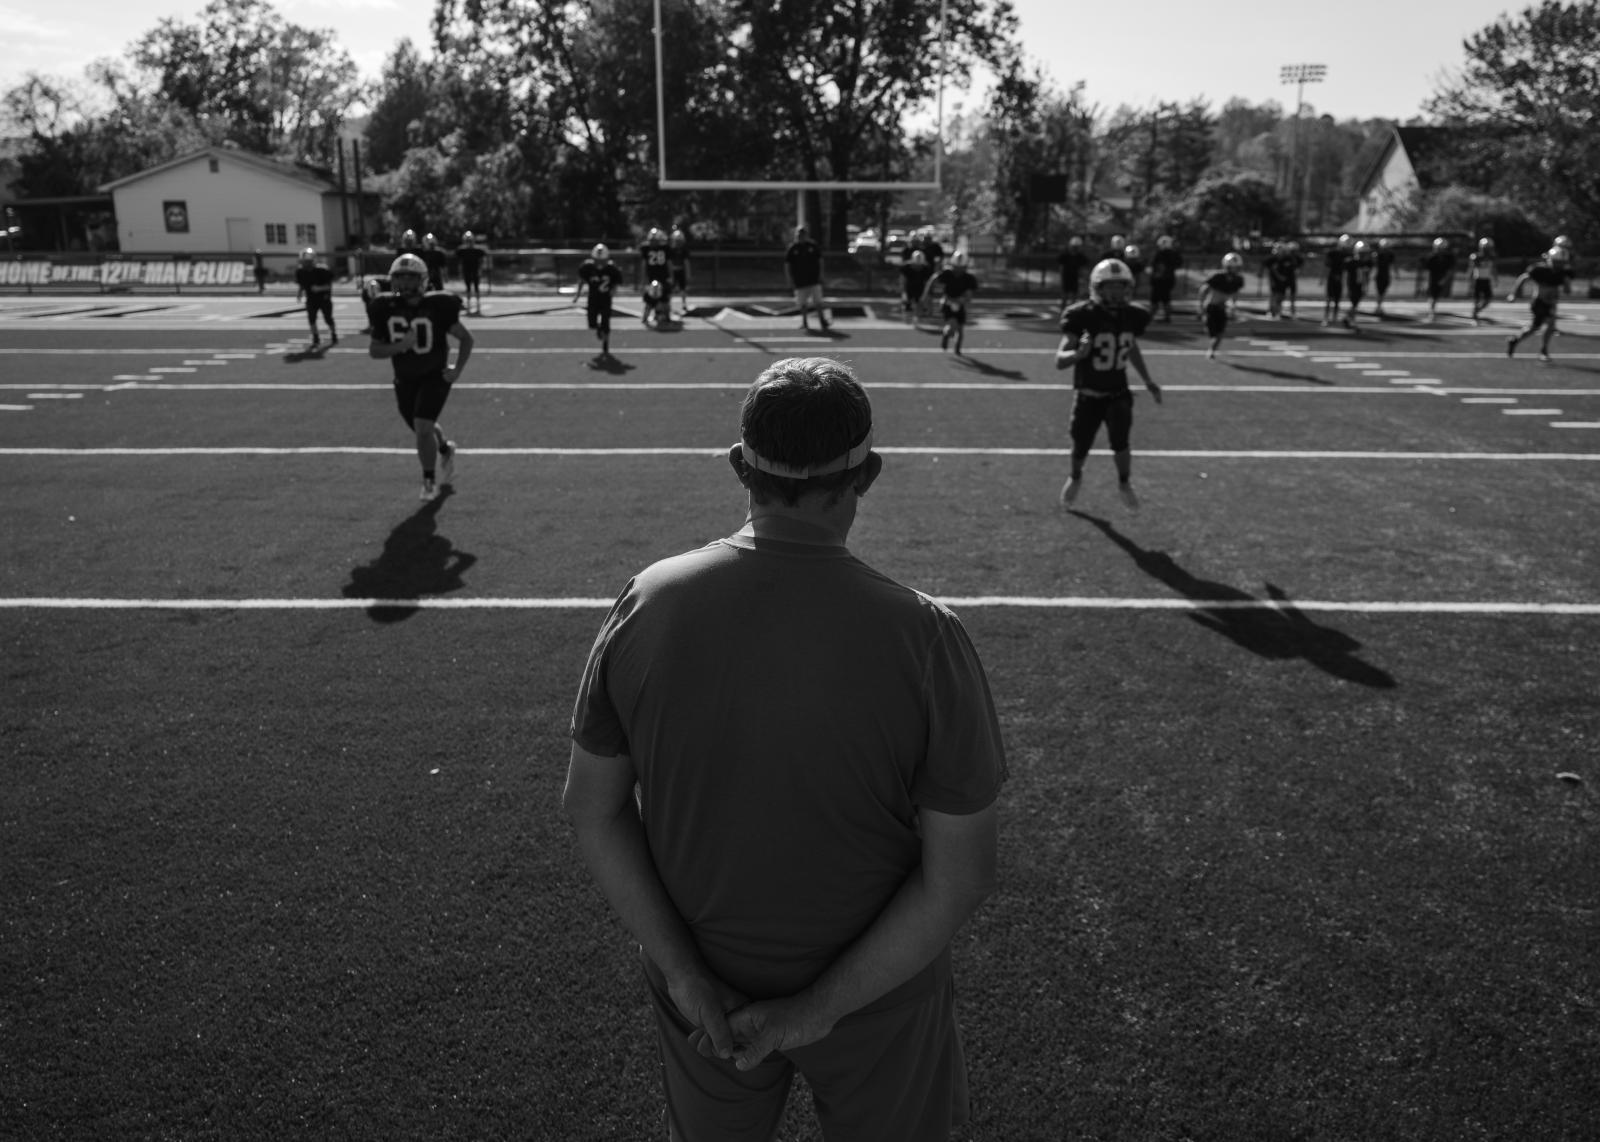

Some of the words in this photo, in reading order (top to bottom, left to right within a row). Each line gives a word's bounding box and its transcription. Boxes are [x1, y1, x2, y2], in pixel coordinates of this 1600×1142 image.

[100, 261, 142, 284] 12TH
[144, 261, 191, 284] MAN
[192, 261, 246, 284] CLUB
[387, 315, 433, 355] 60
[1092, 331, 1134, 371] 32
